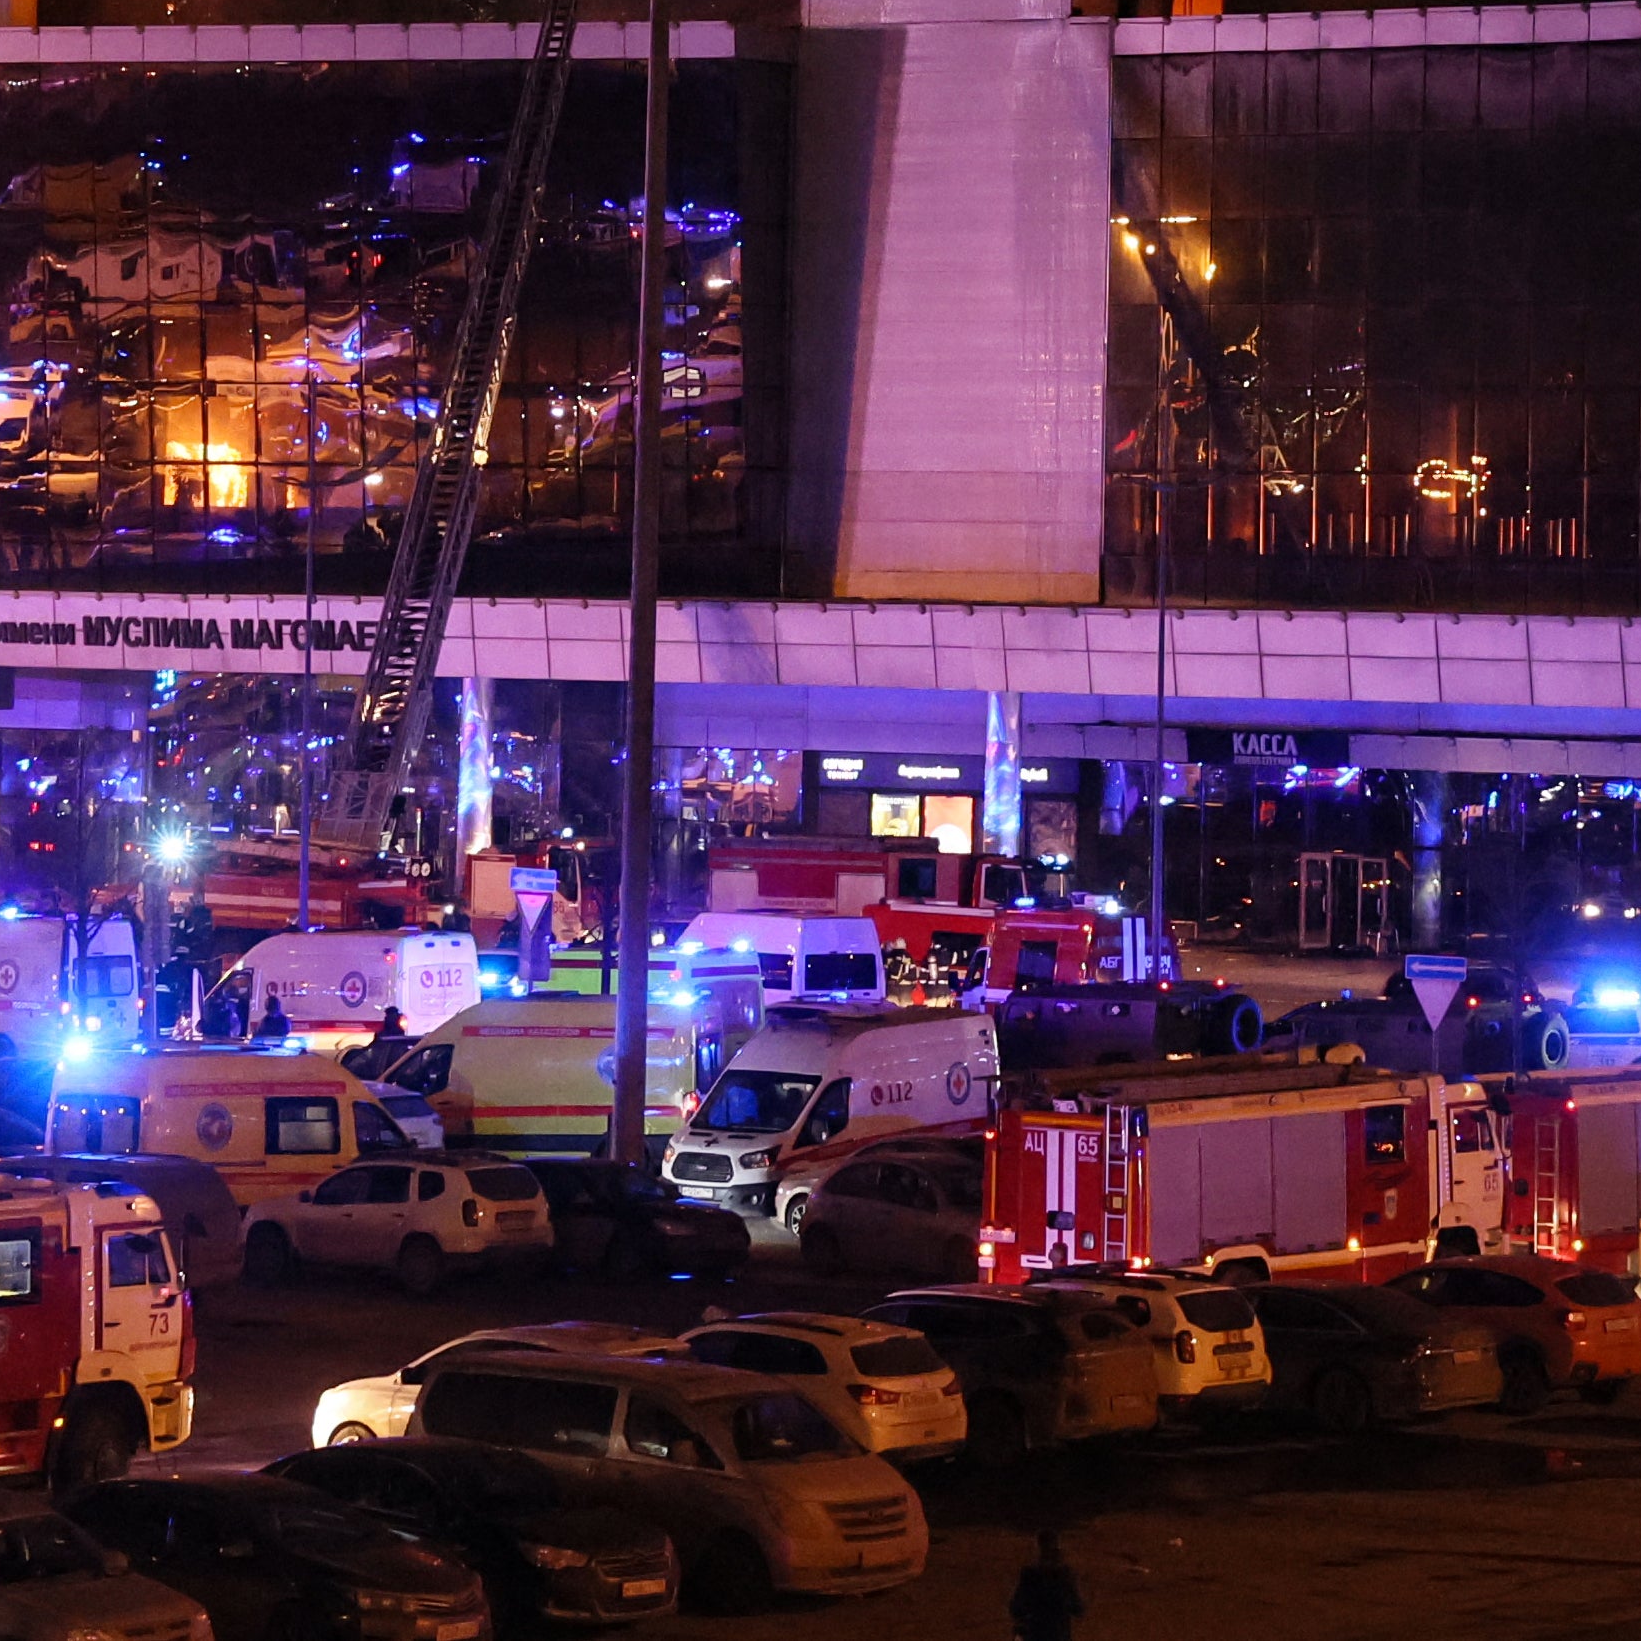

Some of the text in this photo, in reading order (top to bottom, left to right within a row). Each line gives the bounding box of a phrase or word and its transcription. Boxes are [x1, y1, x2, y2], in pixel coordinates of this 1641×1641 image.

[82, 615, 224, 650] МУСЛИМА
[231, 618, 380, 652] МАГОМАЕ
[1233, 732, 1299, 756] КАССА
[437, 968, 463, 988] 112
[886, 1081, 913, 1105] 112
[1024, 1132, 1099, 1156] АЦ 65
[1484, 1173, 1499, 1192] 65
[148, 1312, 170, 1336] 73
